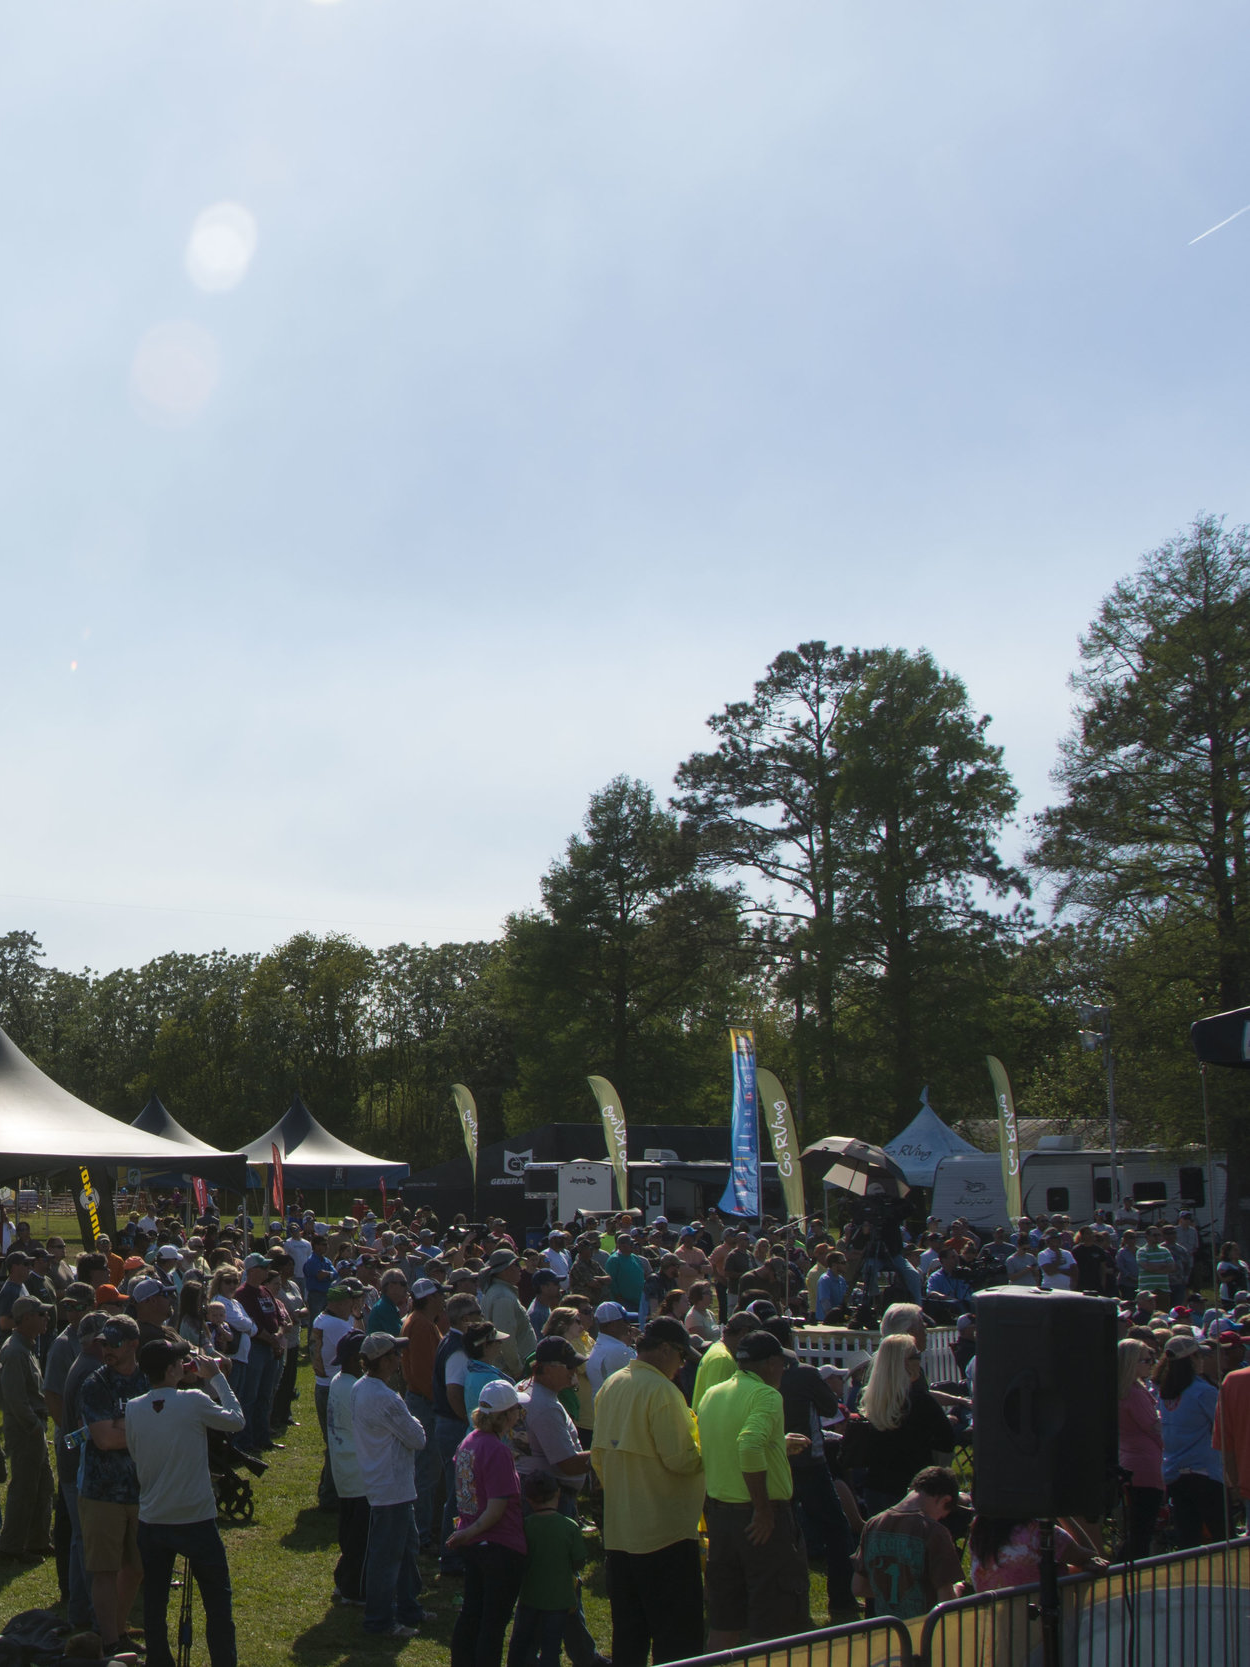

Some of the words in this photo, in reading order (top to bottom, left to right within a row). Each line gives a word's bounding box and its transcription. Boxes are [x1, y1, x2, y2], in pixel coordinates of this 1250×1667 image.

[771, 1100, 787, 1148] RVing
[898, 1143, 932, 1161] RVing
[778, 1152, 792, 1177] Go
[570, 1176, 586, 1184] Jayco
